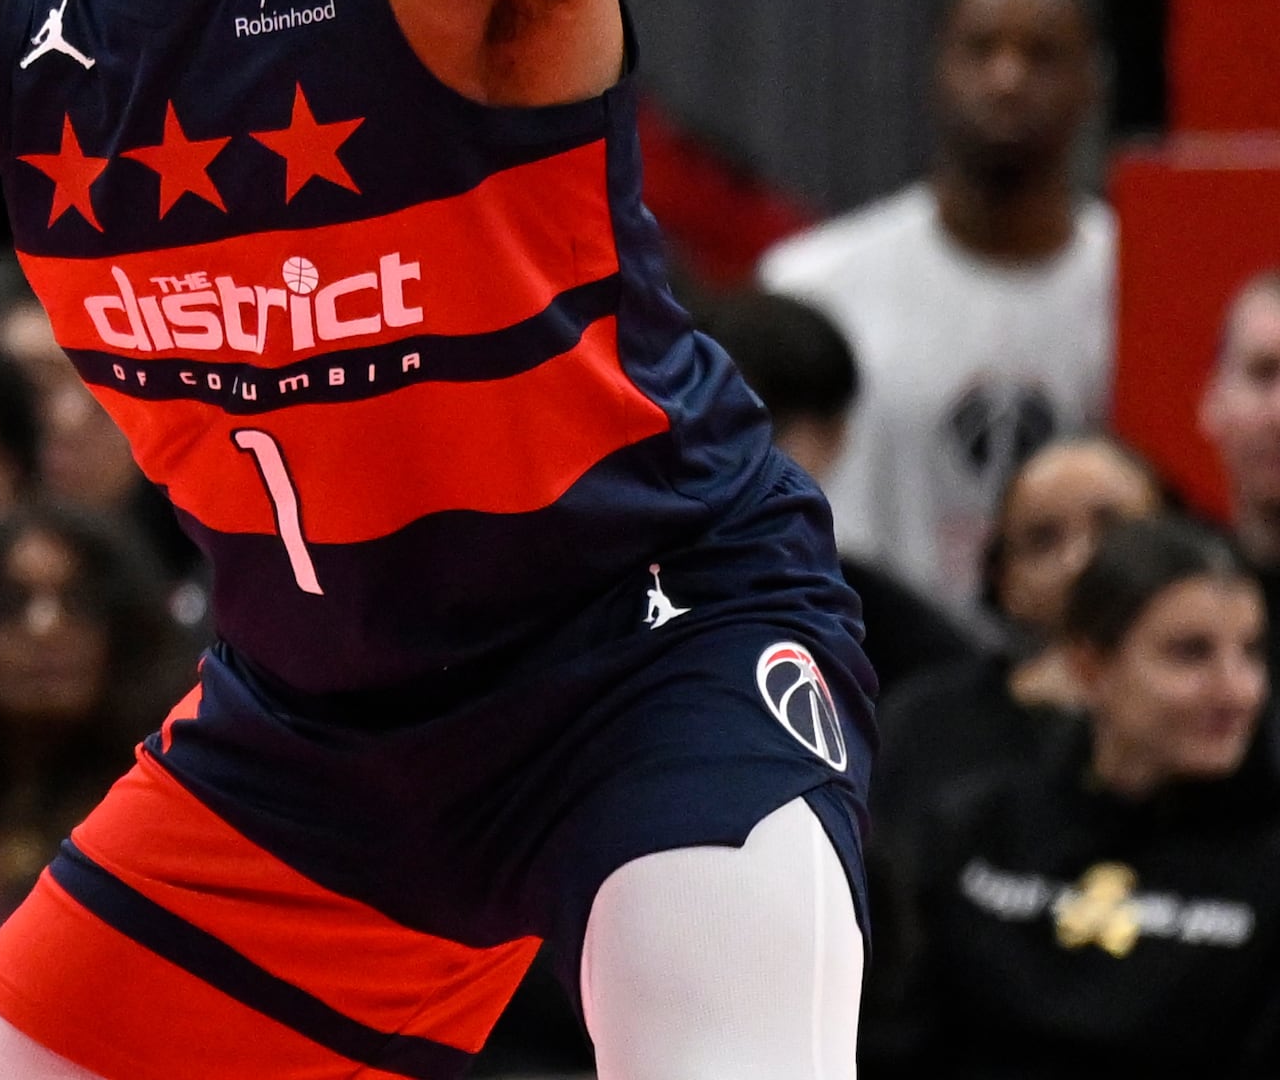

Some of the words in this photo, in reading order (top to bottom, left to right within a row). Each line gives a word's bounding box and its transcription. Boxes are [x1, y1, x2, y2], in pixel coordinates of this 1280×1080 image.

[235, 0, 336, 37] Robinhood
[149, 271, 212, 294] THE
[84, 252, 423, 355] district
[113, 364, 146, 386] OF
[235, 430, 324, 595] 1
